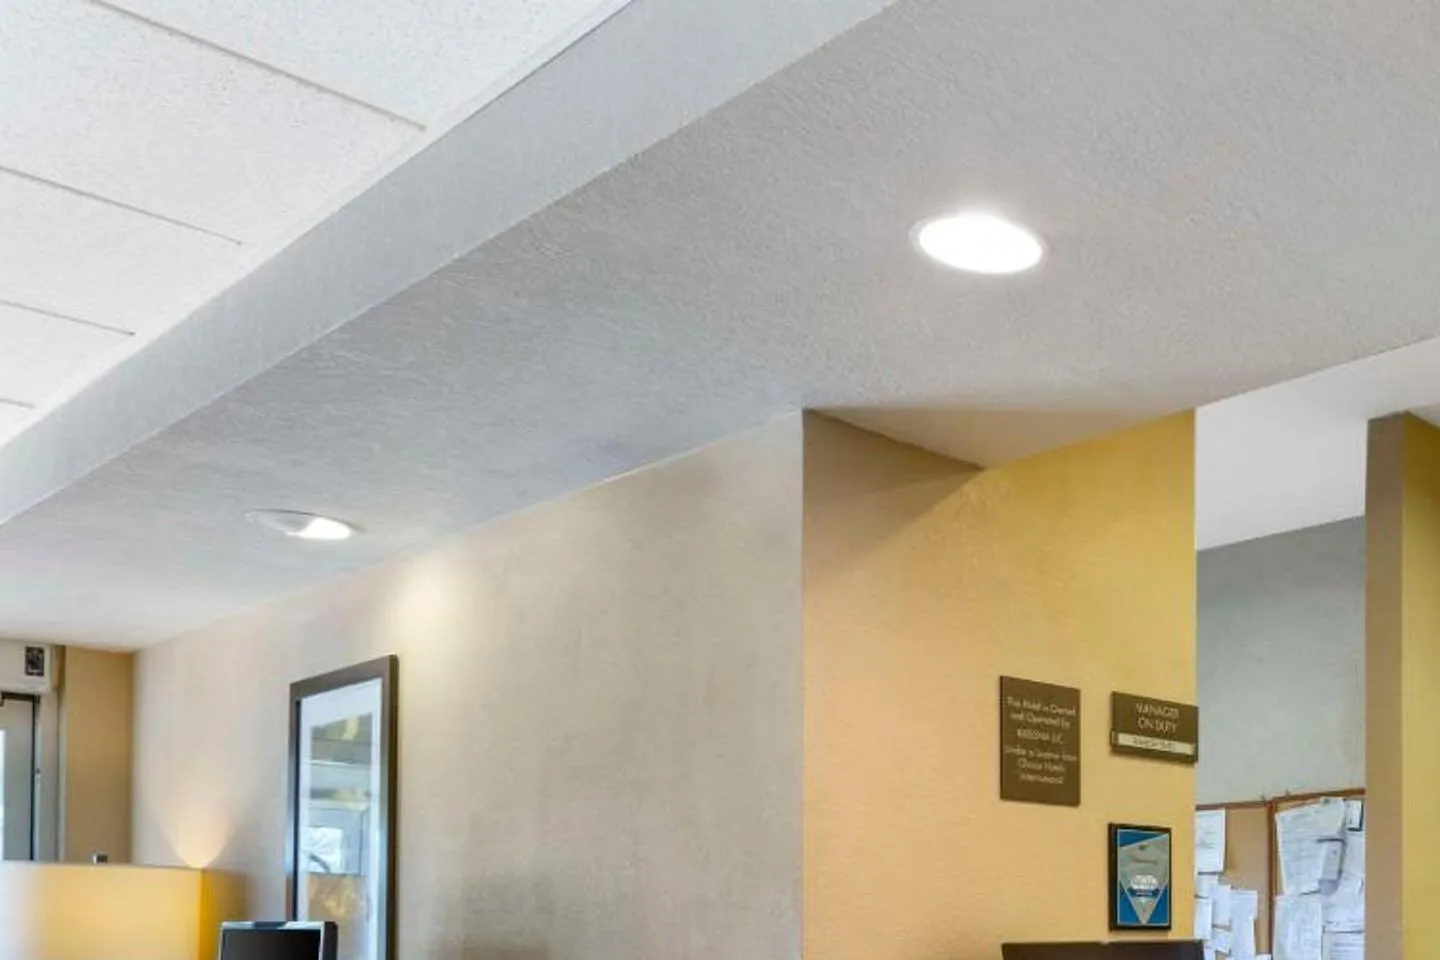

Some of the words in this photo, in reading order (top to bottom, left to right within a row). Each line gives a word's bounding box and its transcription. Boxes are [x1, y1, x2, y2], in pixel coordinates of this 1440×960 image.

[1049, 704, 1076, 717] Owned
[1136, 703, 1179, 720] MANAGER
[1137, 716, 1154, 729] ON
[1155, 719, 1178, 734] DUTY
